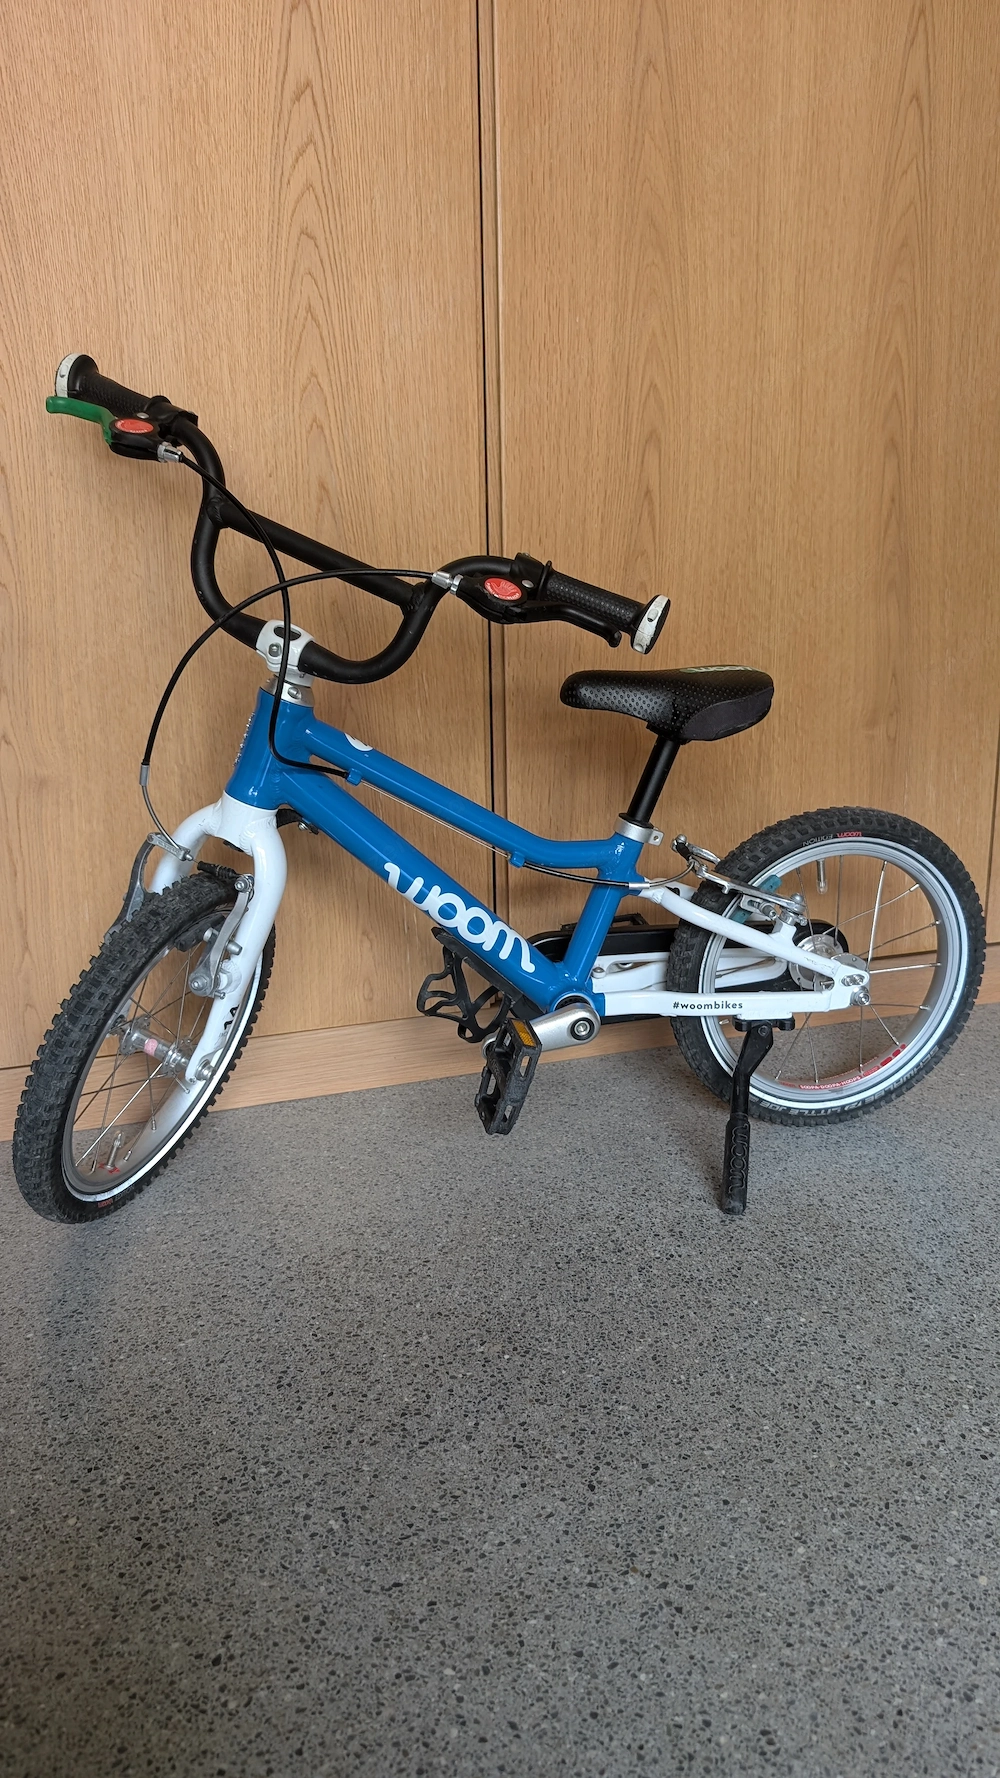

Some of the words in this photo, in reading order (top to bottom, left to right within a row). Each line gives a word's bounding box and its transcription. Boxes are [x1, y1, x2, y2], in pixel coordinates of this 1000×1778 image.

[802, 833, 834, 847] EDITION
[836, 831, 862, 839] woom
[384, 862, 535, 973] woom
[672, 1001, 743, 1010] #woombikes
[864, 1045, 939, 1104] SCHWALBE
[760, 1101, 787, 1112] JOE
[788, 1106, 841, 1117] LITTLE
[728, 1123, 749, 1194] woom
